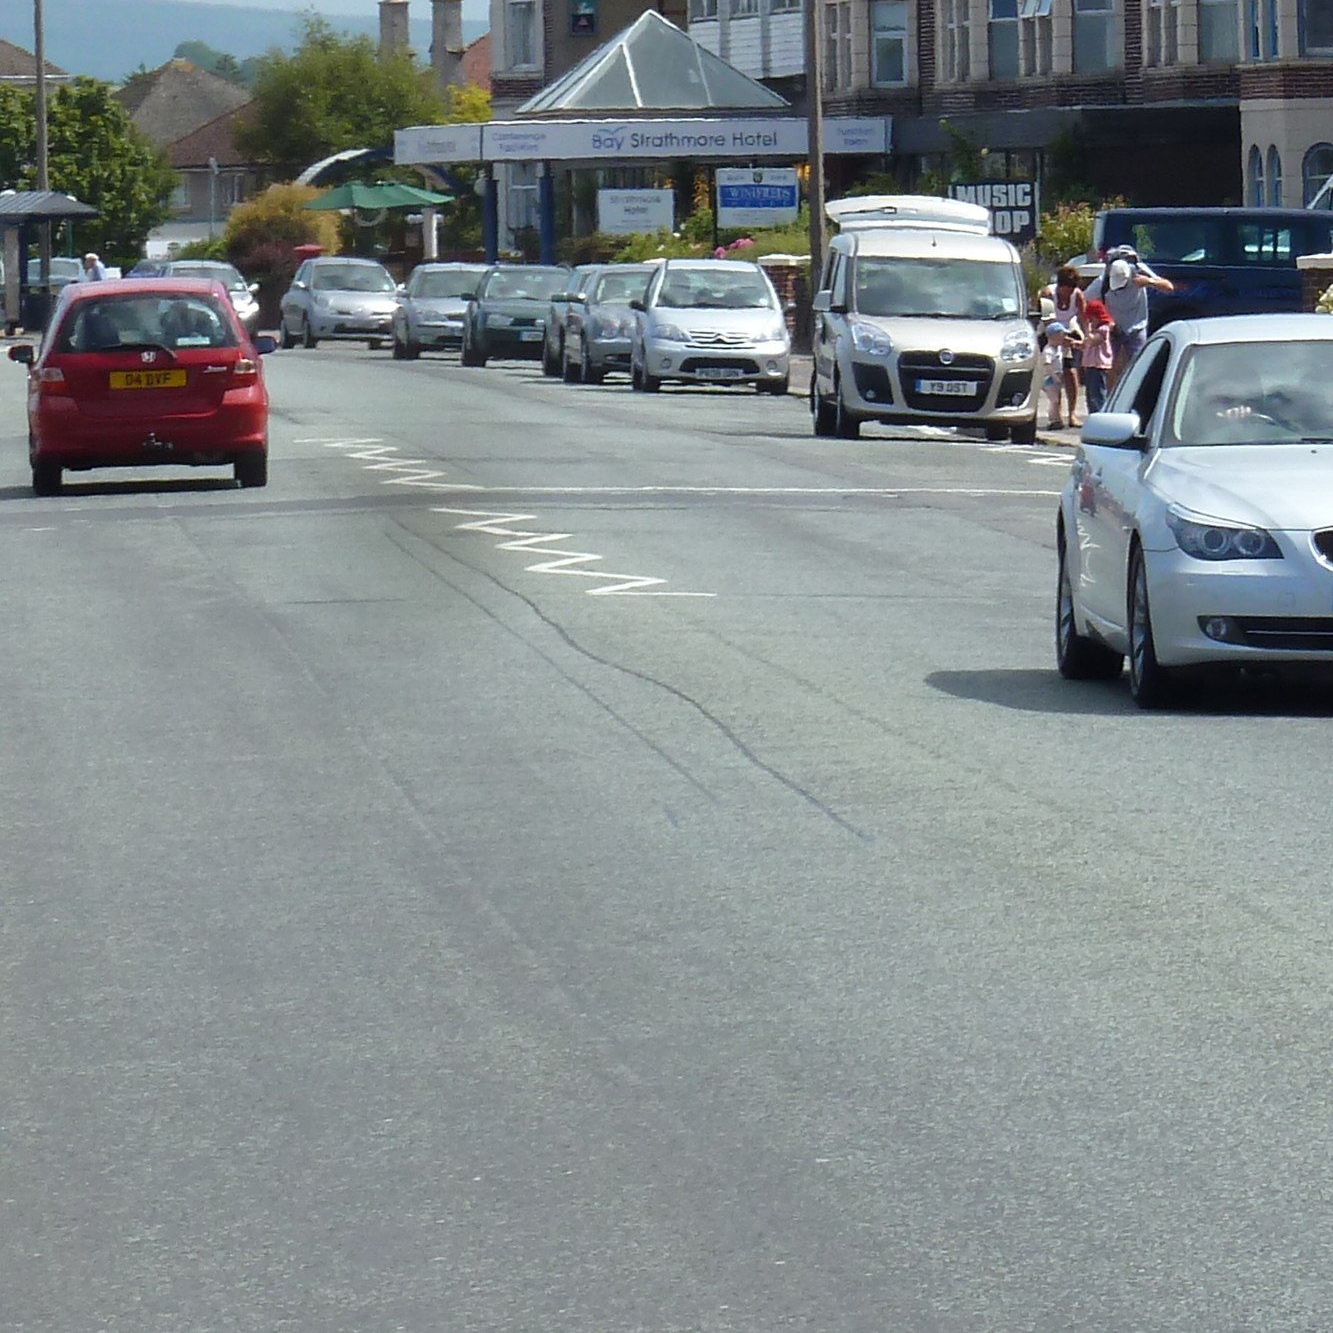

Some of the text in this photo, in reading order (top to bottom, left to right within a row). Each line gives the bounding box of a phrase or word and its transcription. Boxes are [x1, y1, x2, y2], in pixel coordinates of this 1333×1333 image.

[592, 131, 778, 152] Bay Strathmore Hotel
[955, 183, 1032, 208] MUSIC
